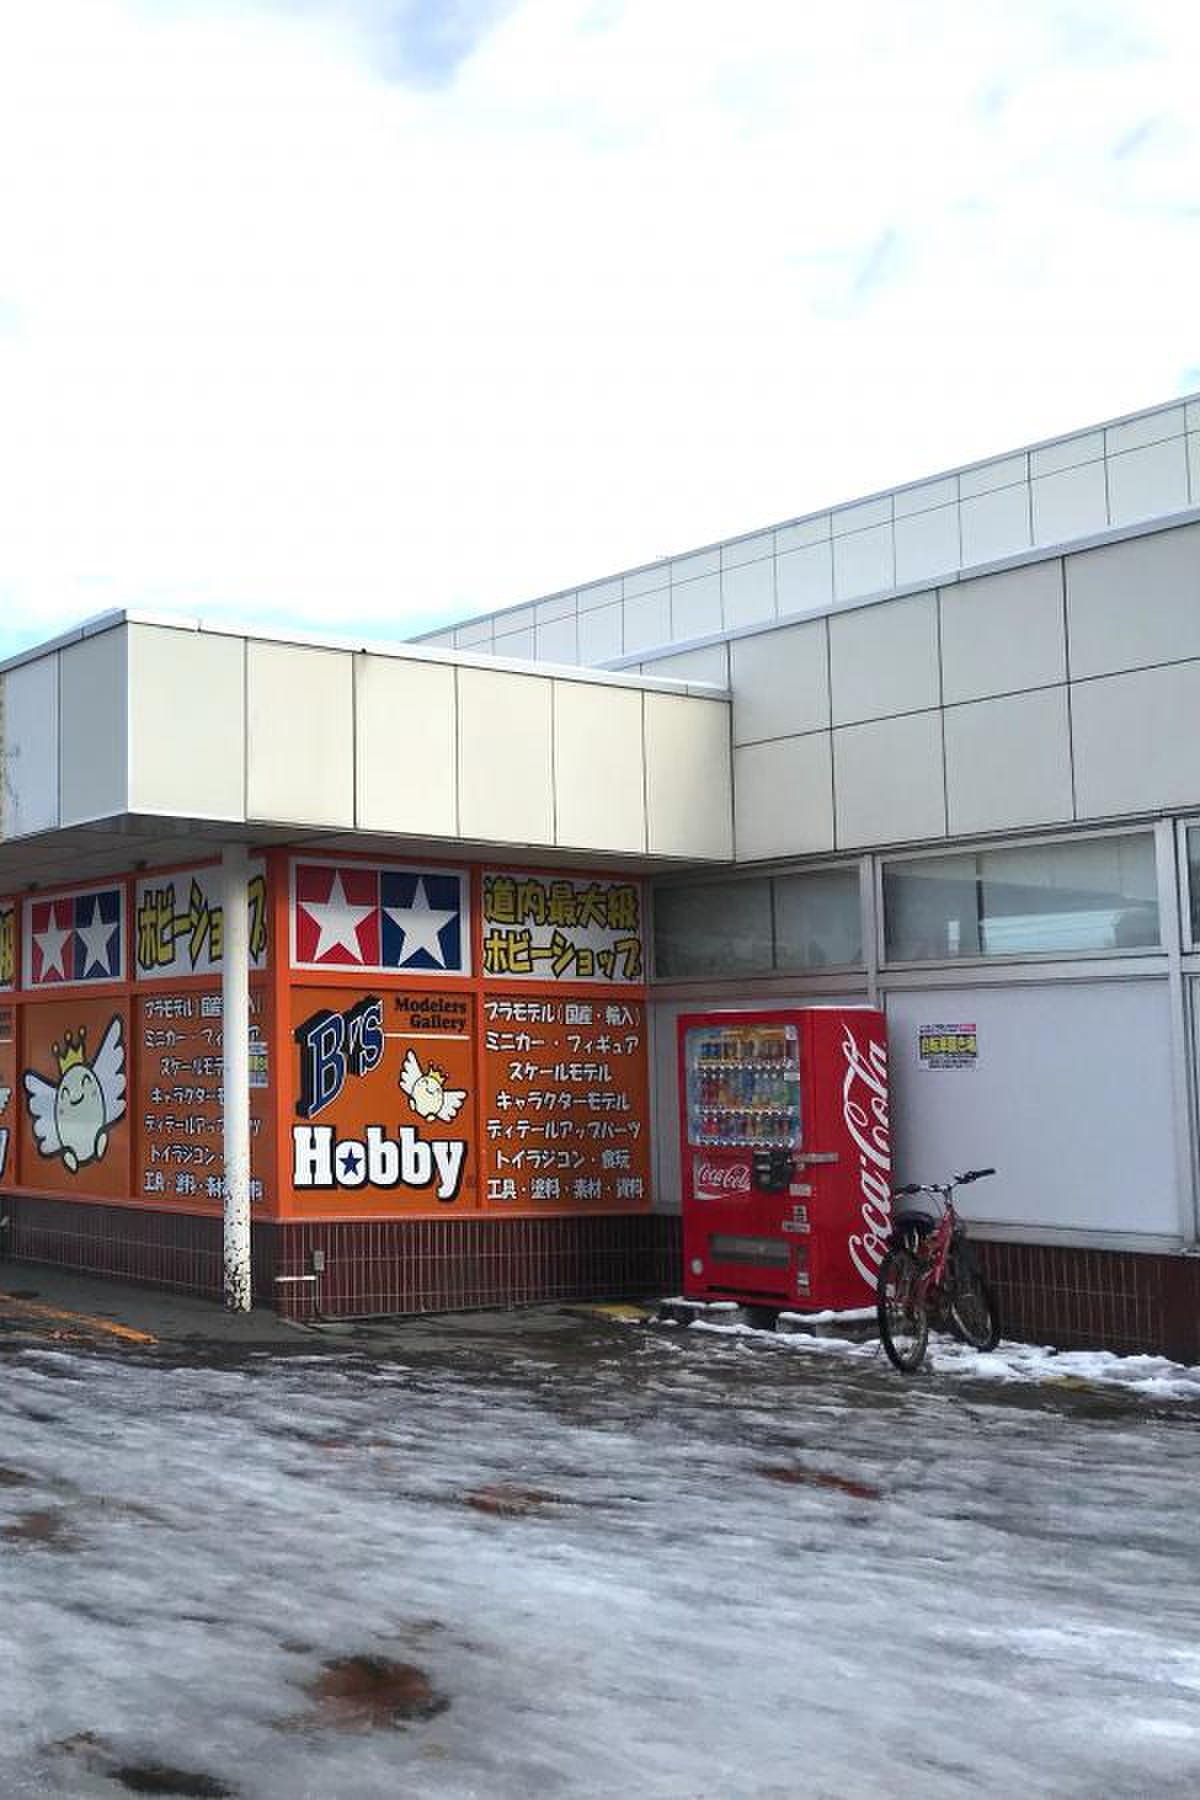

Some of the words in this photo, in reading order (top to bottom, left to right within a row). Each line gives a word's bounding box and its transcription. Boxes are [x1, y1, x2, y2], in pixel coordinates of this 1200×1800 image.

[138, 877, 267, 971] ホビーショプ
[484, 875, 638, 931] 道内最大級
[484, 927, 642, 979] ホビーショップ
[395, 998, 466, 1014] Modelers
[410, 1014, 466, 1032] Gallery
[297, 995, 385, 1119] B's
[509, 1061, 612, 1082] スケールモデル
[496, 1090, 631, 1111] キャラクターモデル
[292, 1124, 466, 1200] Hobby
[698, 1163, 750, 1189] Coca-Cola
[843, 1022, 892, 1292] Coca-Cola
